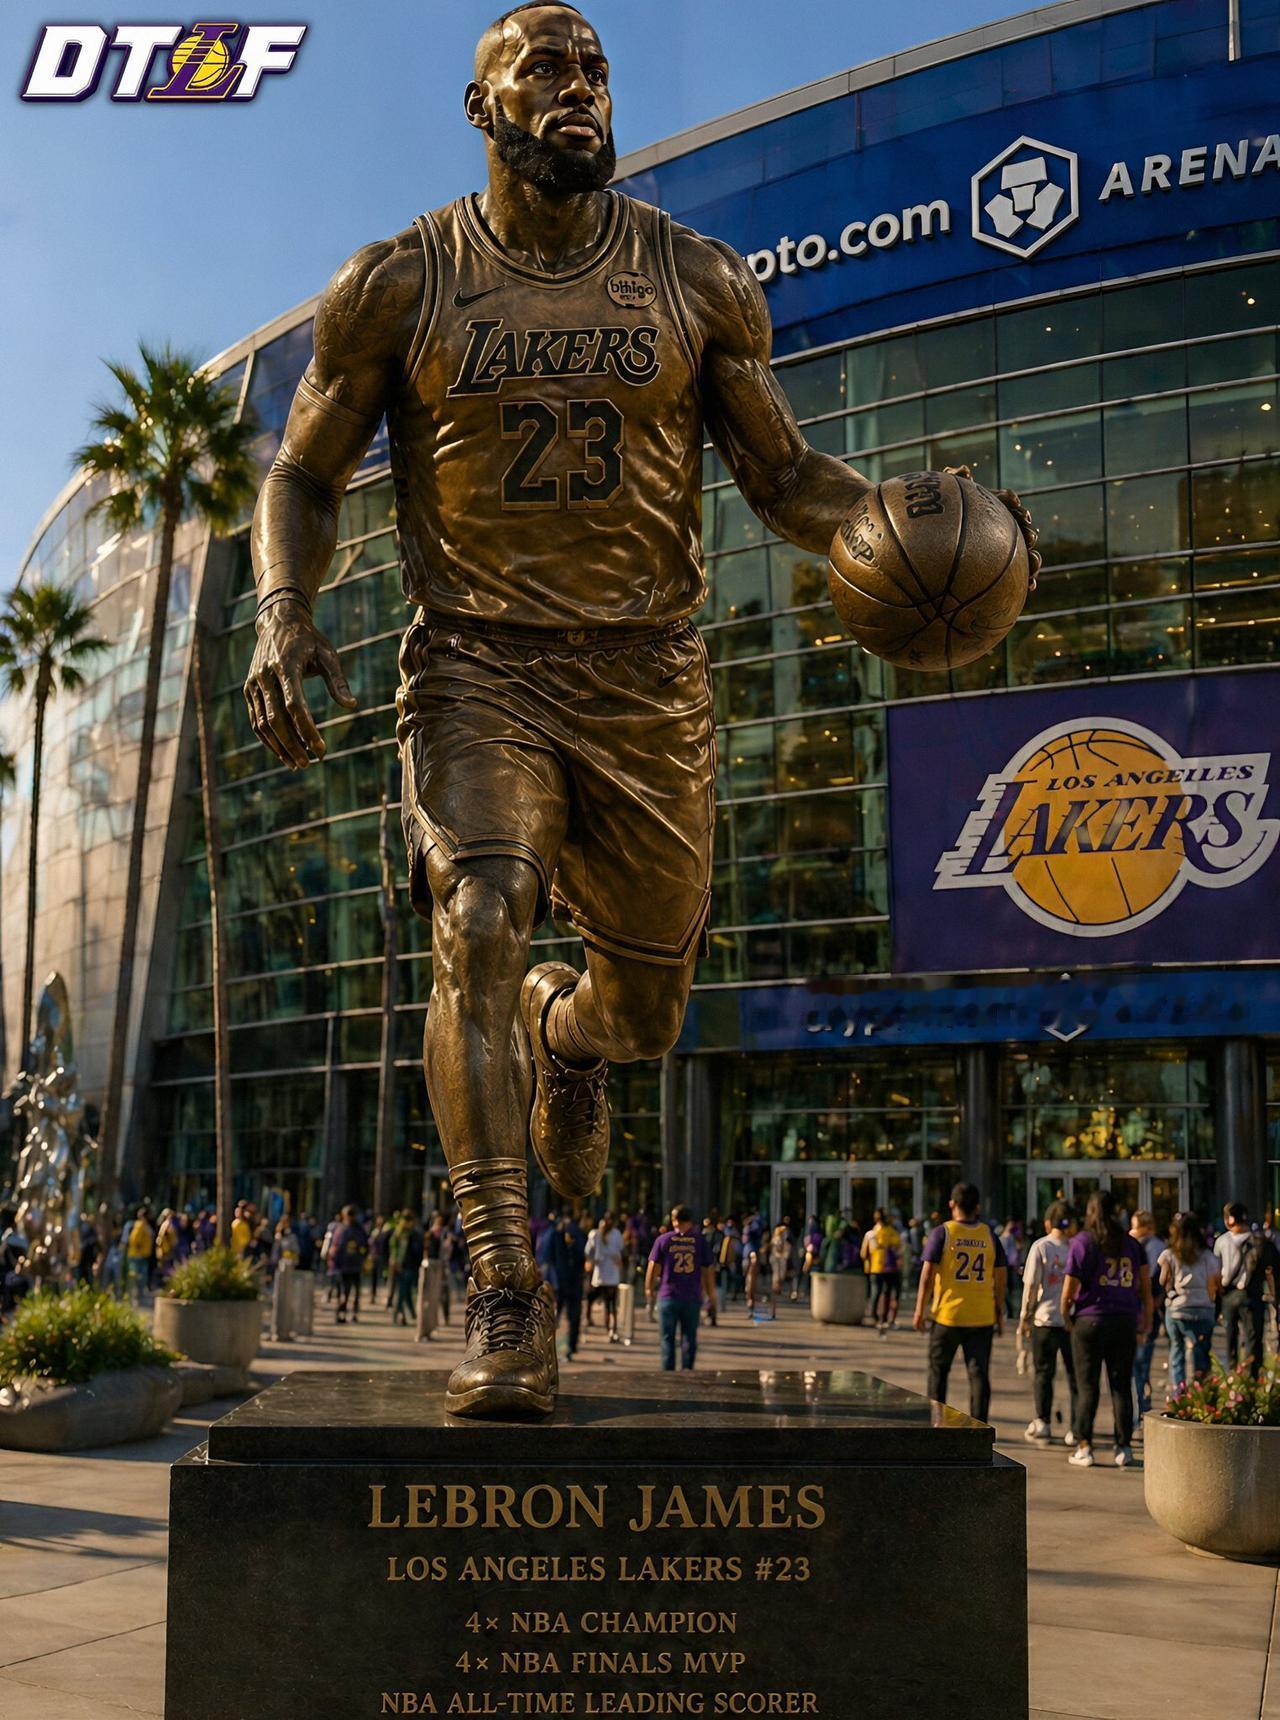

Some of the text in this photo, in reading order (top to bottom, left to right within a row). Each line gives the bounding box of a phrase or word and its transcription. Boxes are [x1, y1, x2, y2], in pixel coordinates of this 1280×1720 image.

[743, 134, 1280, 283] pto.com ARENA
[446, 318, 661, 397] LAKERS
[499, 399, 625, 511] 23
[1046, 775, 1097, 791] LOS
[952, 779, 1266, 876] LAKERS
[673, 1253, 695, 1273] 23
[955, 1252, 985, 1281] 24
[368, 1484, 825, 1532] LEBRON JAMES
[387, 1557, 810, 1581] LOS ANGELES LAKERS #23
[511, 1612, 571, 1633] NBA
[581, 1611, 737, 1634] CHAMPION
[501, 1652, 560, 1673] NBA
[571, 1652, 673, 1674] FINALS
[683, 1652, 746, 1673] MVP
[381, 1692, 819, 1714] NBA ALL-TIME LEADING SCORER
